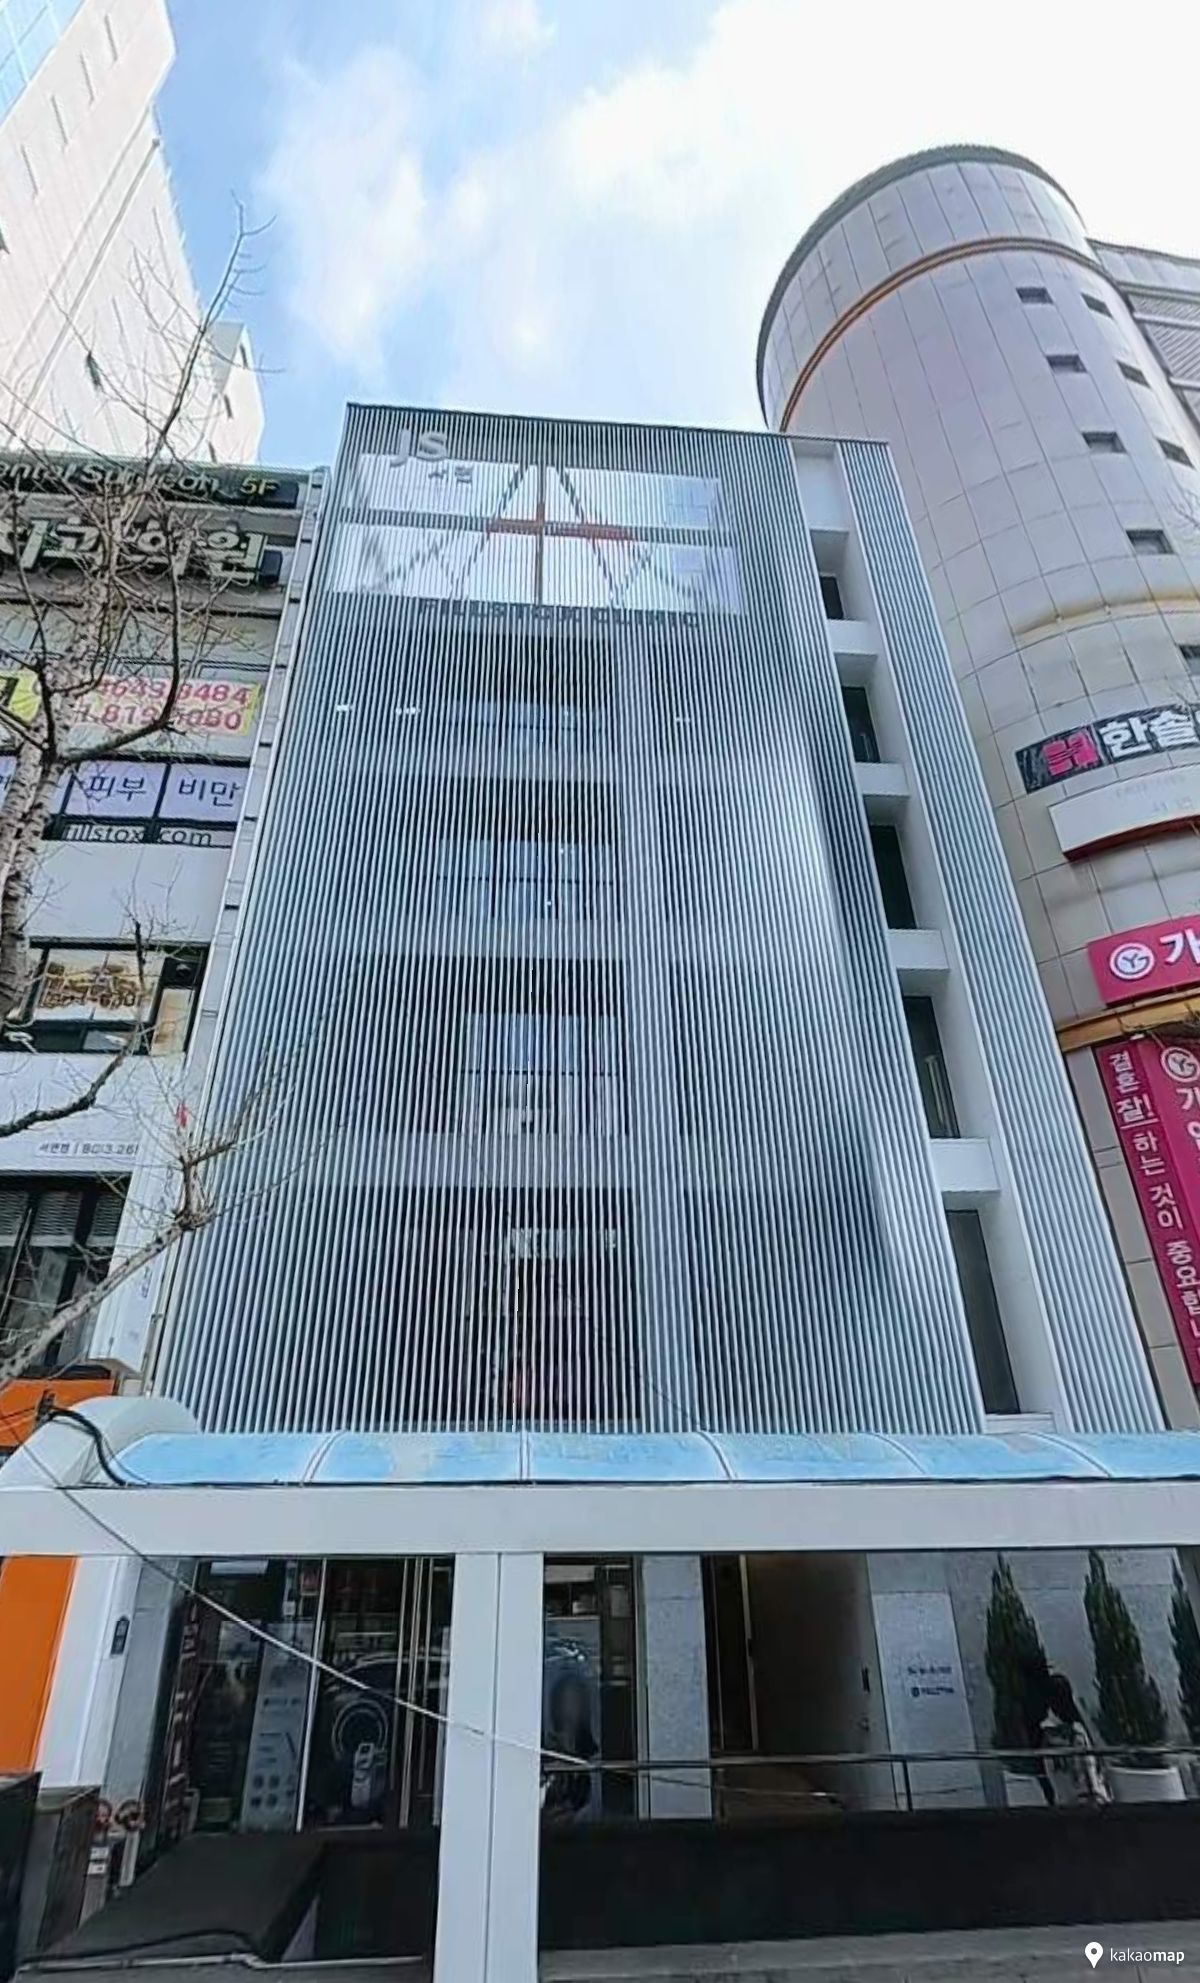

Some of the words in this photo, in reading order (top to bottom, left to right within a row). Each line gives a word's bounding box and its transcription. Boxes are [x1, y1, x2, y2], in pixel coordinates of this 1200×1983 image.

[241, 476, 279, 497] 5F
[1100, 710, 1200, 759] 한솔
[90, 776, 147, 801] 피부
[178, 779, 243, 808] 비만
[1132, 1130, 1166, 1177] 하는
[1149, 1182, 1184, 1230] 것이
[1167, 1240, 1200, 1365] 중요합
